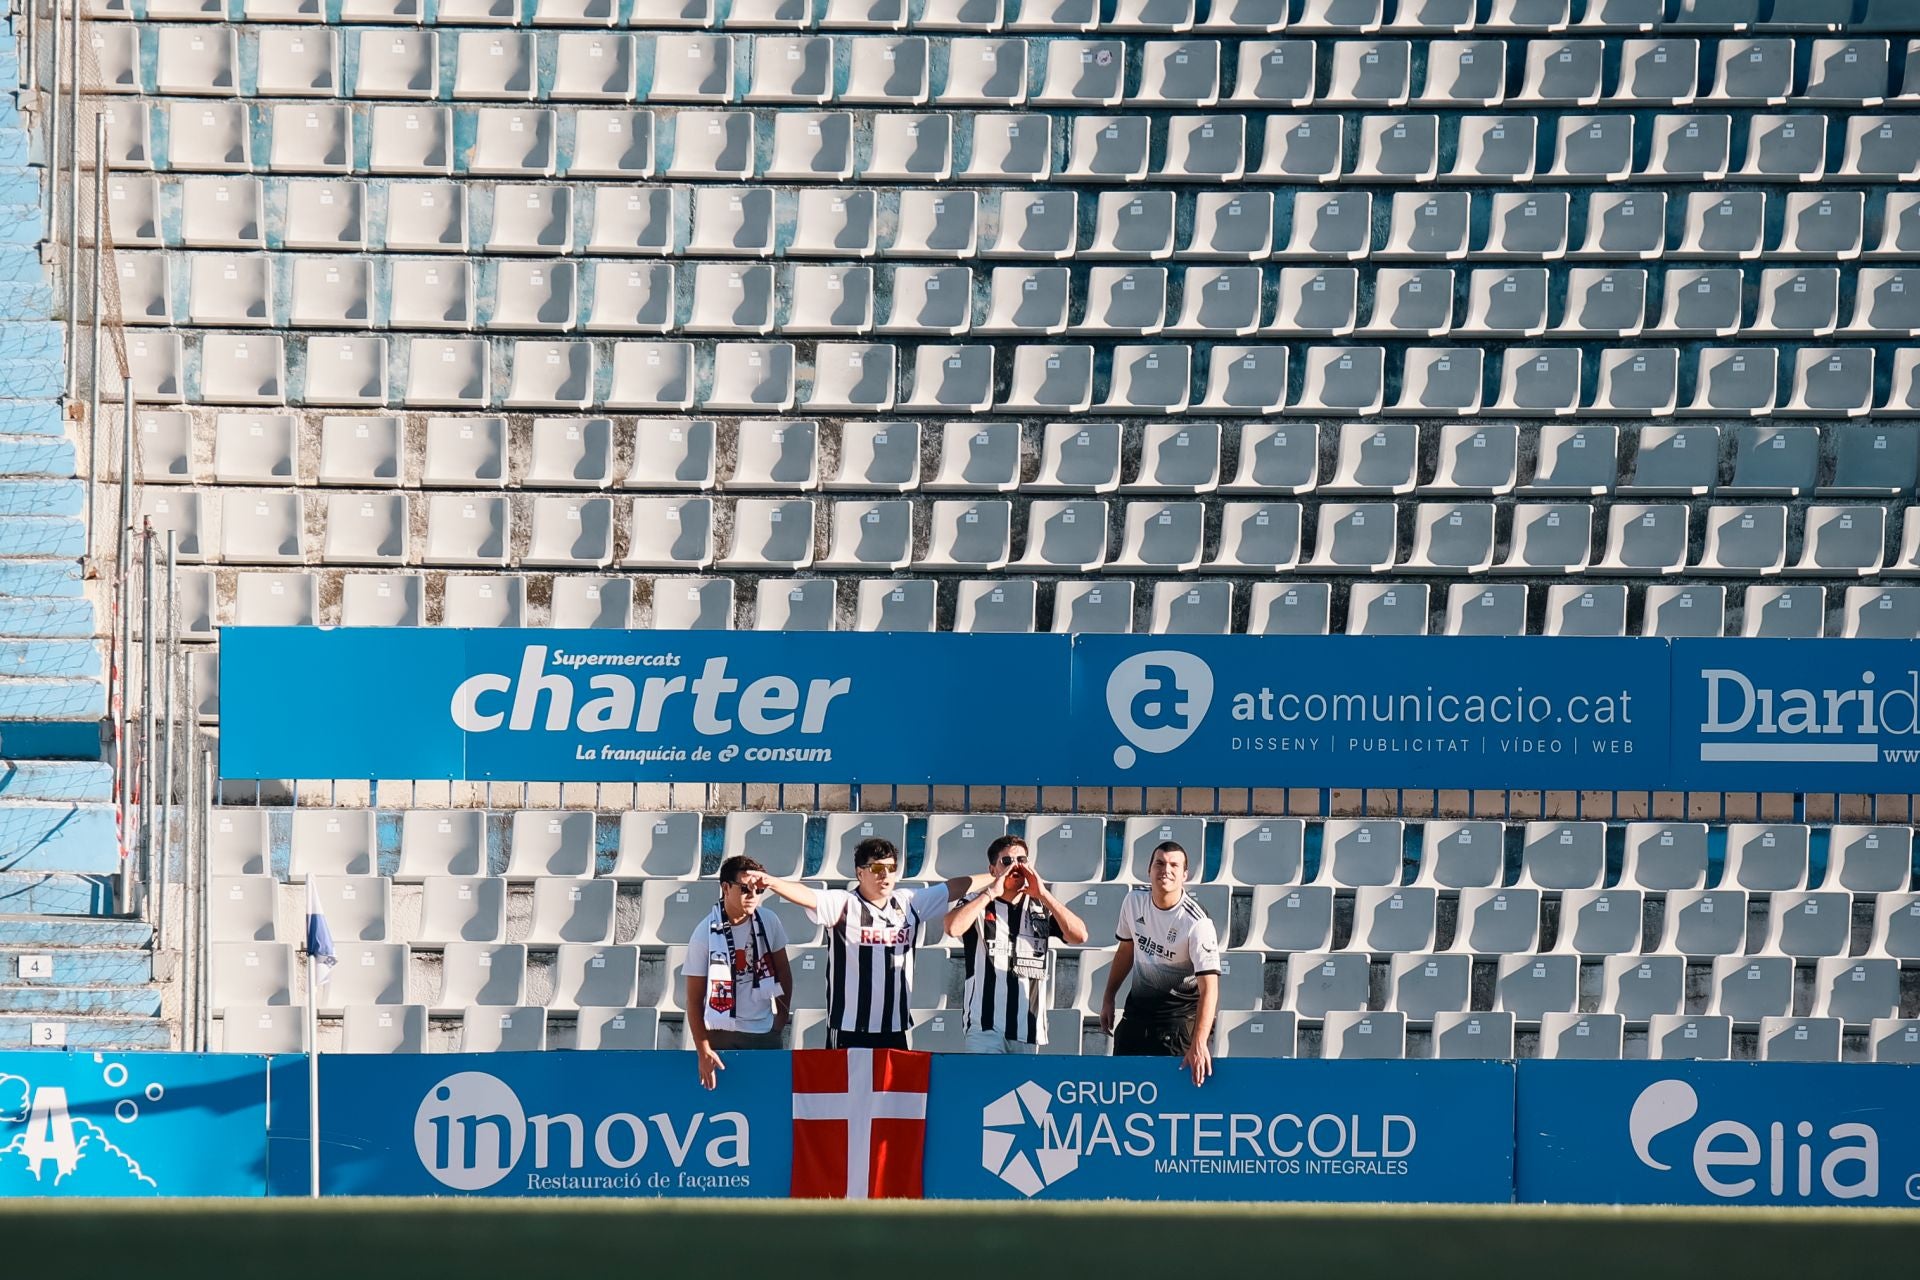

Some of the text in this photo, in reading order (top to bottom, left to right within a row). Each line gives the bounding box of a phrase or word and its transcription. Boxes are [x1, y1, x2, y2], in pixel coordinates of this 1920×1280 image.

[552, 649, 681, 668] Supermercats
[451, 645, 851, 736] charter
[1232, 686, 1632, 725] atcomunicacio.cat
[576, 745, 833, 764] La franquícia de consum
[1232, 736, 1634, 754] DISSENY PUBLICITAT VÍDEO WEB
[30, 960, 40, 973] 4
[44, 1027, 53, 1041] 3
[1056, 1081, 1159, 1105] GRUPO
[1043, 1112, 1417, 1159] MASTERCOLD
[1154, 1159, 1409, 1175] MANTENIMIENTOS INTEGRALES
[1692, 1120, 1880, 1199] elia
[527, 1172, 751, 1194] Restauració de façanes
